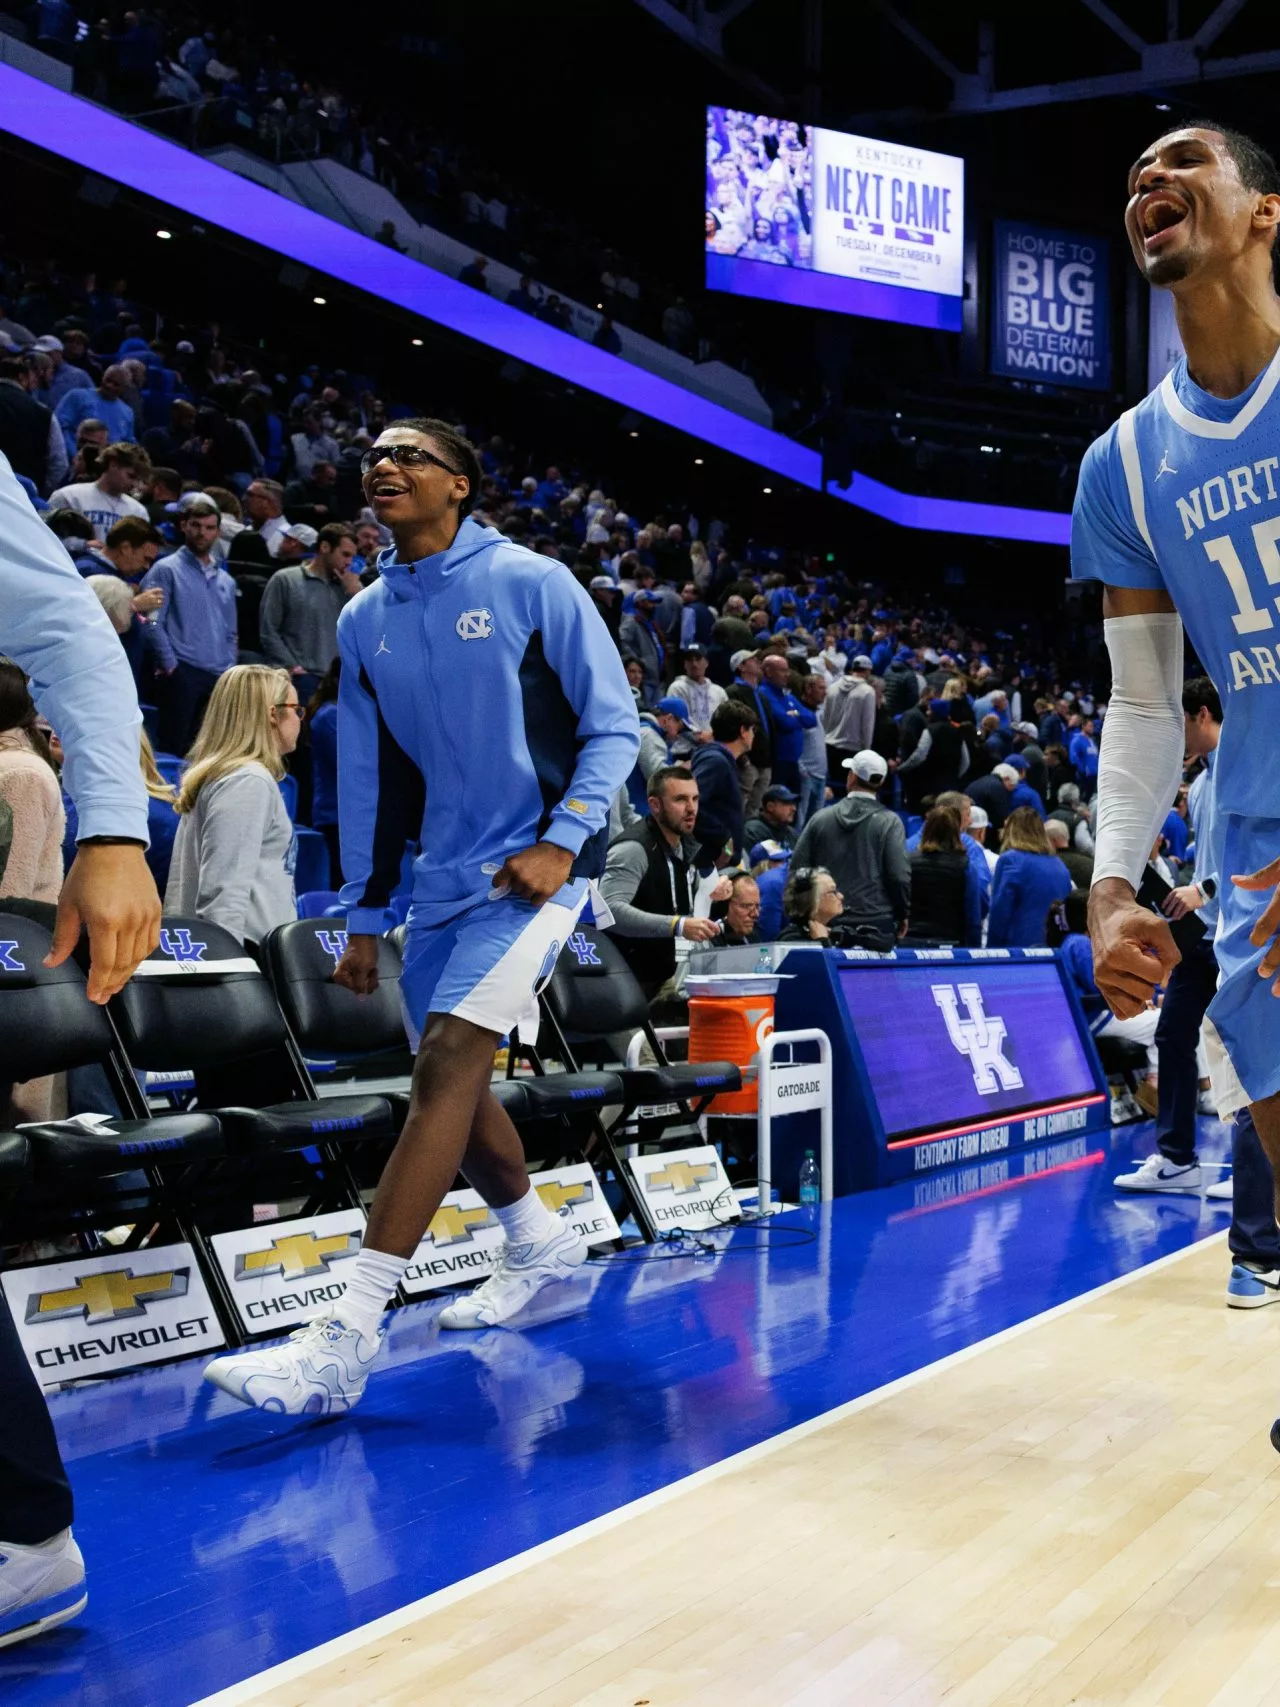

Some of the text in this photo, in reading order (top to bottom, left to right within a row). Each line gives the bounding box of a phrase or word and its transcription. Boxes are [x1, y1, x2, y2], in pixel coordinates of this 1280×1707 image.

[856, 146, 922, 170] KENTUCKY
[826, 164, 951, 233] NEXT GAME
[883, 244, 933, 264] DECEMBER
[1007, 232, 1096, 264] HOME TO
[1007, 251, 1095, 306] BIG
[1007, 295, 1094, 337] BLUE
[1006, 326, 1094, 357] DETERMI
[1006, 347, 1094, 378] NATION
[931, 983, 1024, 1095] UK
[777, 1081, 820, 1098] GATORADE
[1024, 1118, 1037, 1141] BIG
[914, 1126, 1009, 1170] KENTUCKY FARM BUREAU
[655, 1195, 733, 1221] CHEVROLET
[245, 1282, 347, 1319] CHEVRO
[35, 1316, 209, 1369] CHEVROLET
